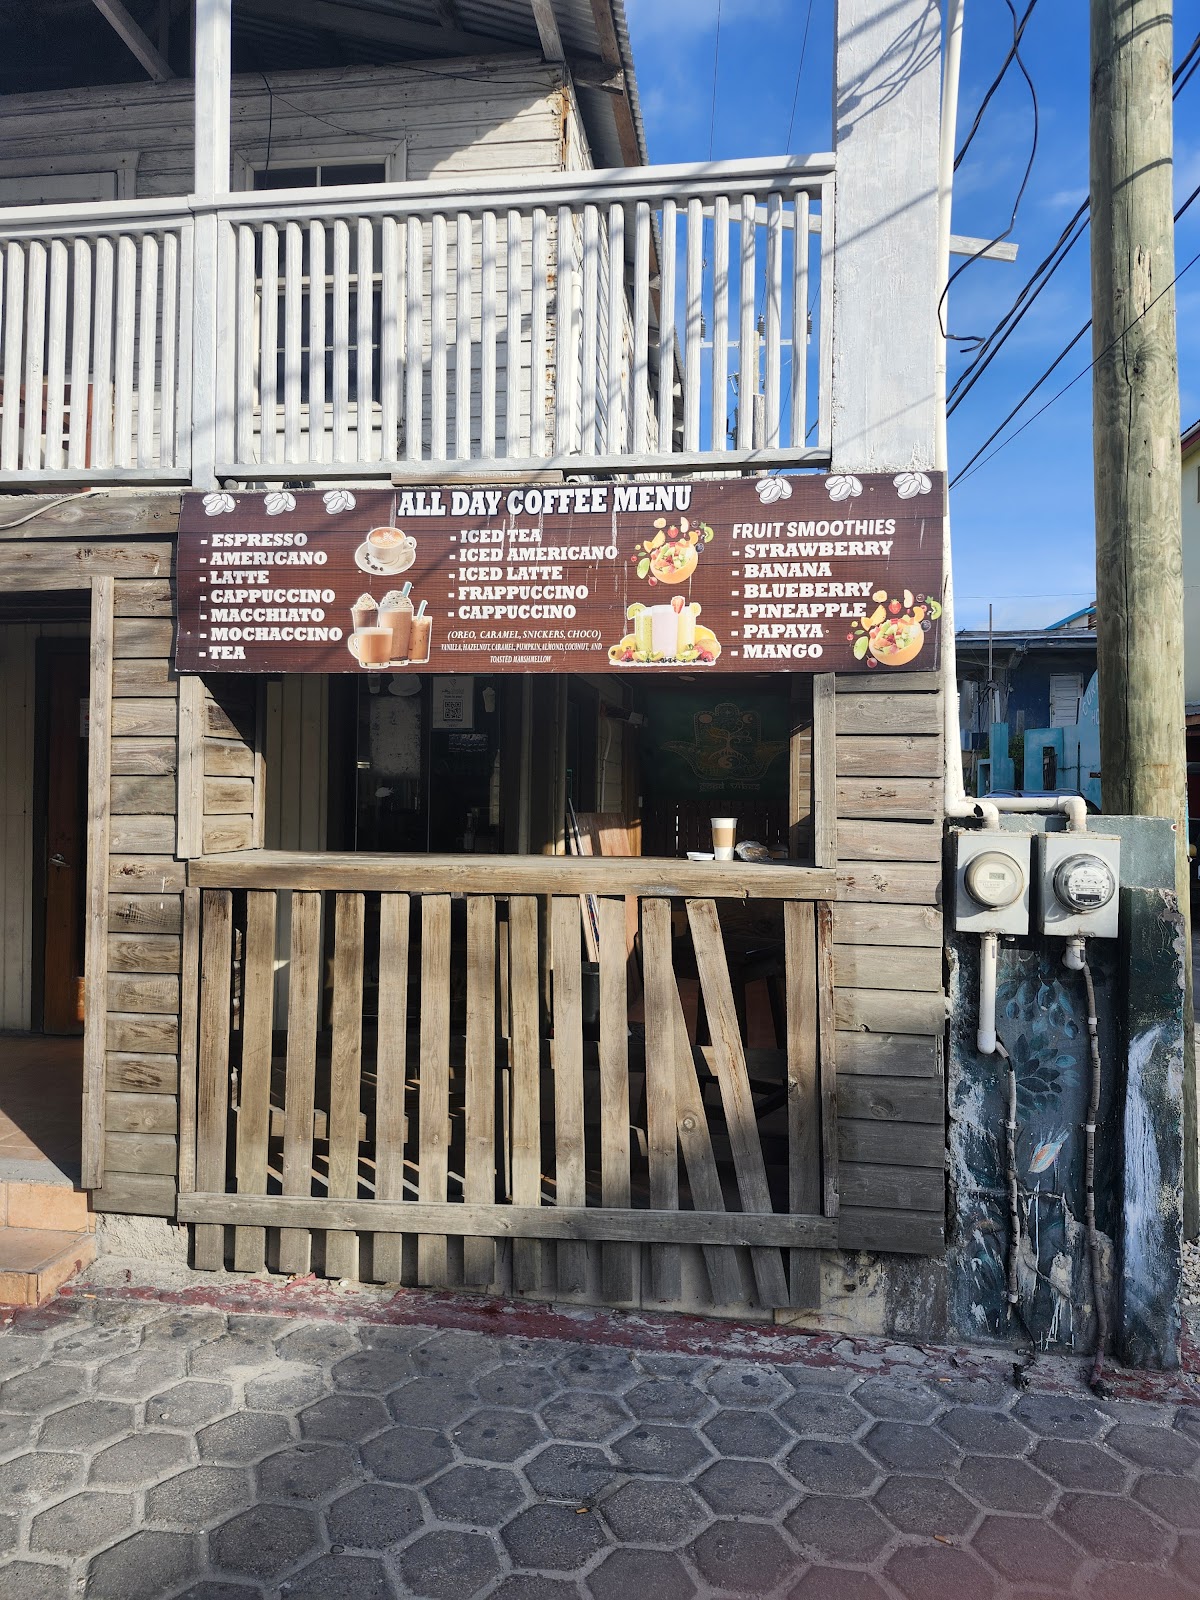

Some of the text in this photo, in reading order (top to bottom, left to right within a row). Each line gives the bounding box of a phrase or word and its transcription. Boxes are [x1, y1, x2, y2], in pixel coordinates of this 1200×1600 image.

[398, 485, 692, 516] ALL DAY COFFEE MENU
[460, 528, 542, 543] ICED TEA
[732, 519, 896, 539] FRUIT SMOOTHIES
[211, 533, 308, 547] ESPRESSO
[459, 546, 618, 562] ICED AMERICANO
[744, 540, 894, 558] STRAWBERRY
[210, 551, 328, 565] AMERICANO
[210, 570, 270, 584] LATTE
[458, 566, 563, 581] ICED LATTE
[744, 562, 832, 578] BANANA
[210, 589, 336, 603] CAPPUCCINO
[458, 585, 589, 600] FRAPPUCCINO
[744, 582, 873, 598] BLUEBERRY
[210, 608, 325, 622] MACCHIATO
[458, 604, 577, 620] CAPPUCCINO
[743, 602, 867, 618] PINEAPPLE
[210, 627, 343, 641] MOCHACCINO
[447, 629, 602, 641] (OREO, CARAMEL, SNICKERS, CHOCO)
[743, 623, 824, 638] PAPAYA
[209, 646, 246, 660] TEA
[590, 643, 603, 651] AND
[743, 644, 823, 659] MANGO
[490, 655, 512, 663] TOASTED
